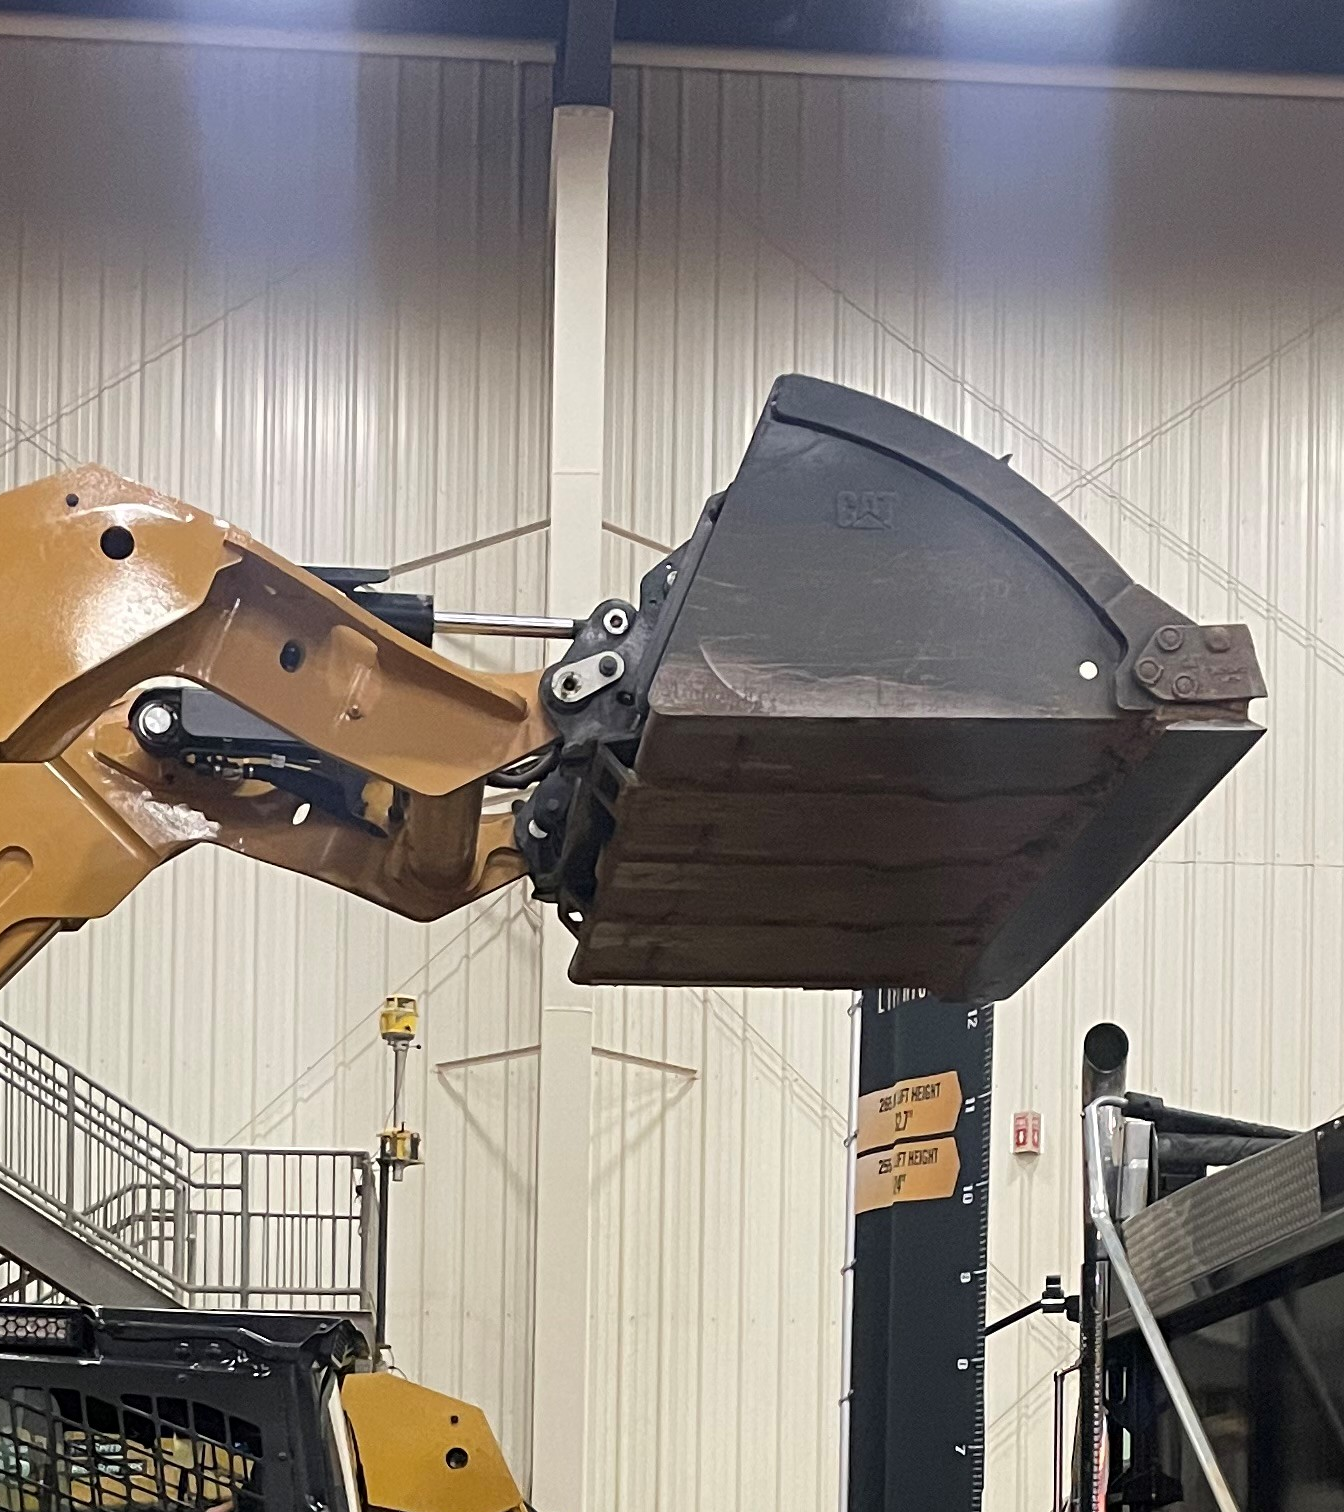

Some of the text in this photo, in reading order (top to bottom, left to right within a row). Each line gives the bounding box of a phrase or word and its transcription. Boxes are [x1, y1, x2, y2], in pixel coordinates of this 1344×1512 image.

[911, 1082, 941, 1102] HEIGHT
[907, 1147, 939, 1167] HEIGHT
[955, 1444, 966, 1456] 7
